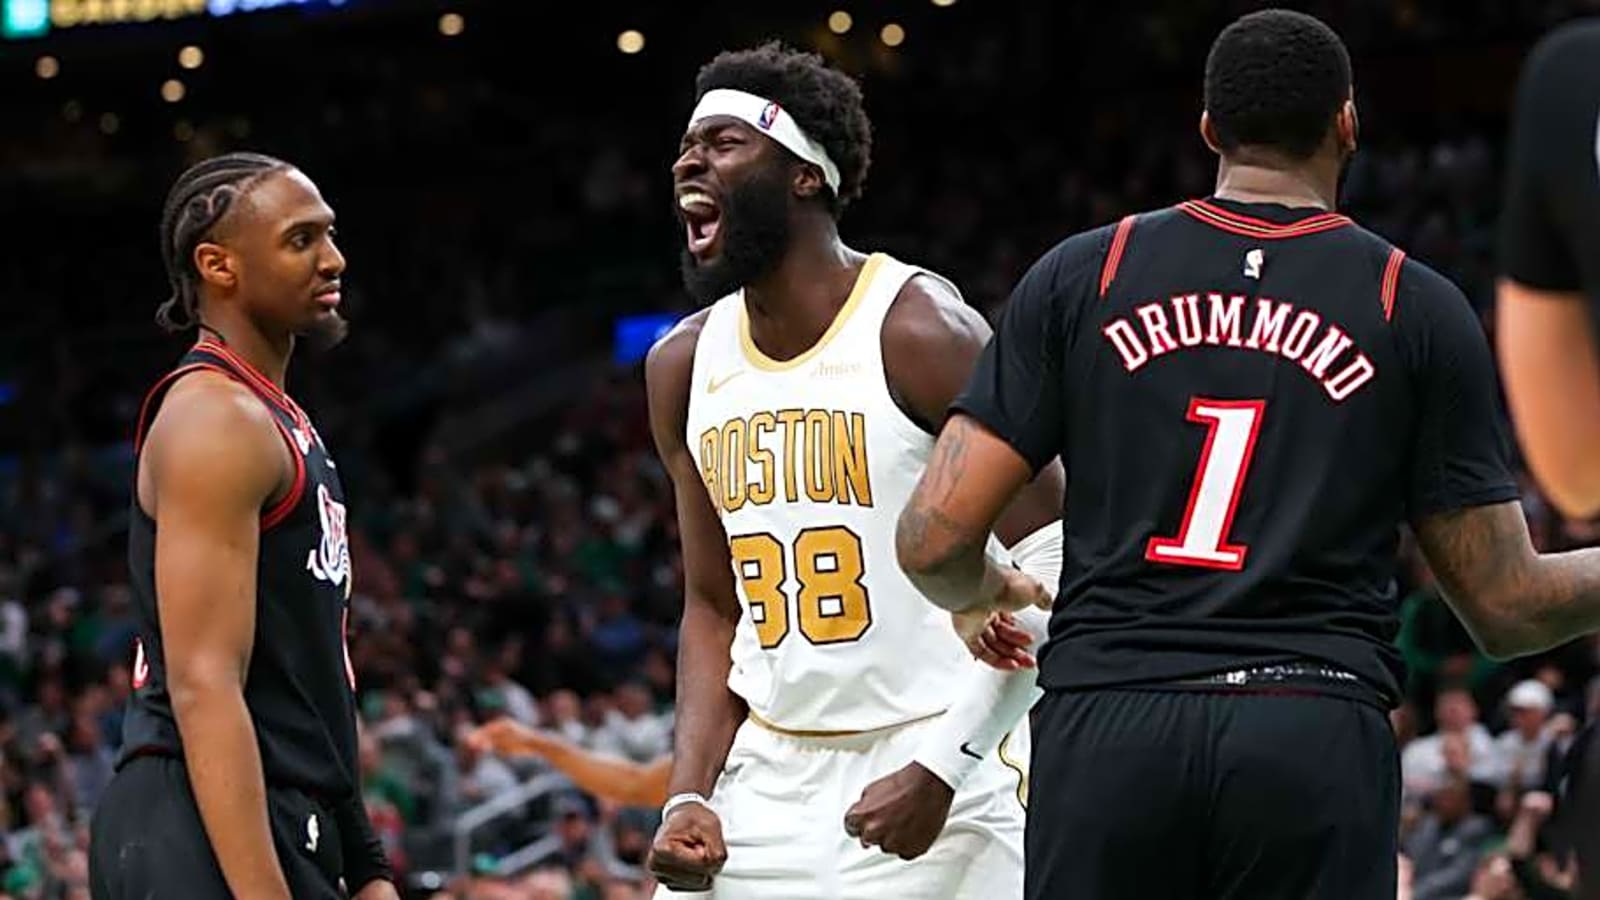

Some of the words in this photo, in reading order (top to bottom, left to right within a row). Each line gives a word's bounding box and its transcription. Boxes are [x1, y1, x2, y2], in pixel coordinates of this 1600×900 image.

[1102, 291, 1377, 402] DRUMMOND
[700, 408, 874, 515] BOSTON
[1144, 397, 1267, 571] 1
